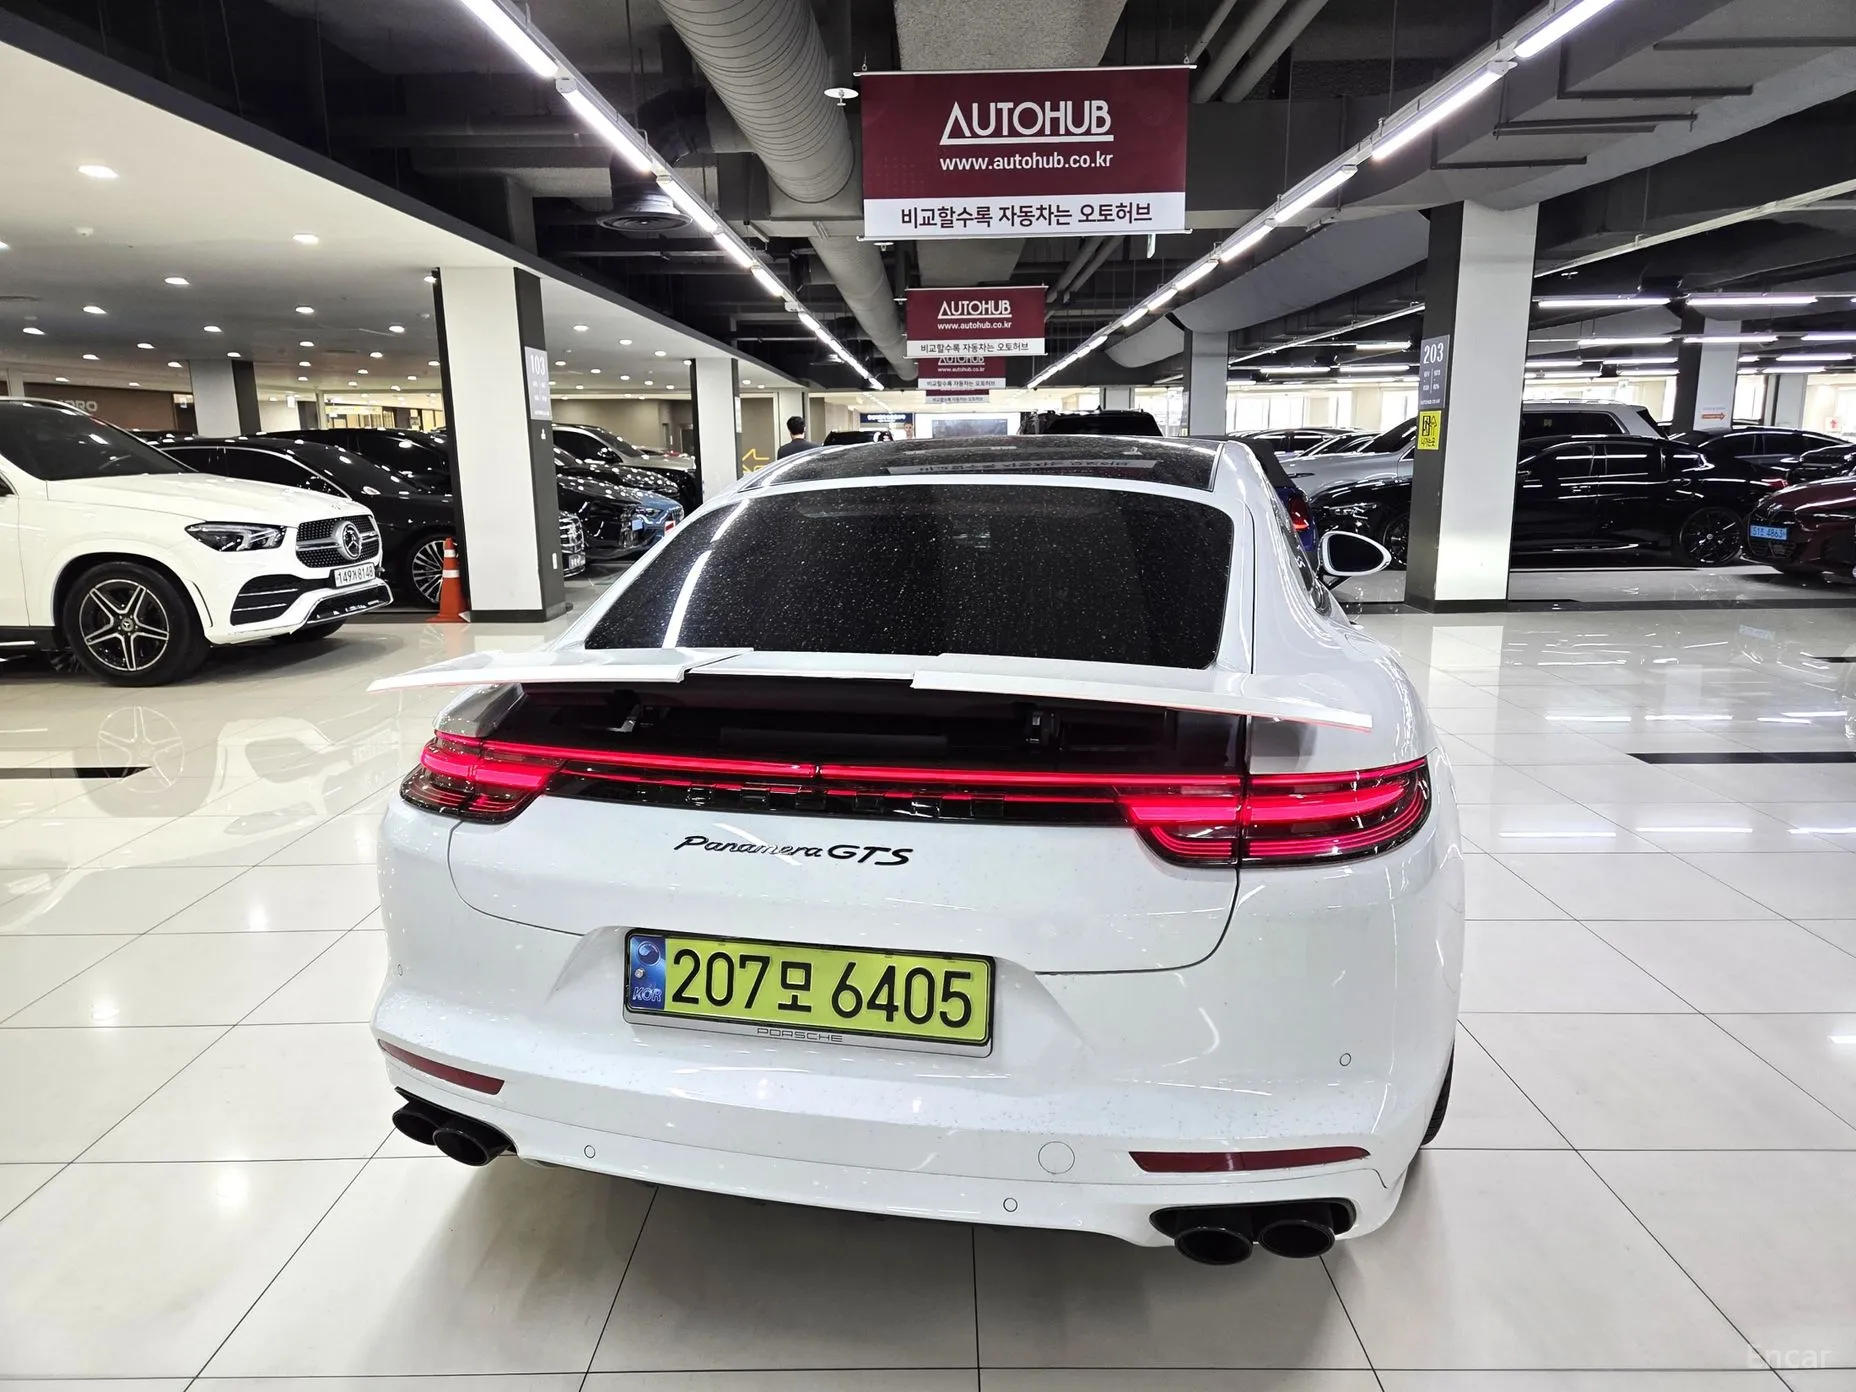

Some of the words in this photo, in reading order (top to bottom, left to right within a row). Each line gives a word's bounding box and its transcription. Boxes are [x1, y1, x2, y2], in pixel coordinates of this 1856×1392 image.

[939, 100, 1114, 145] AUTOHUB
[939, 151, 1114, 171] www.autohub.co.kr
[901, 205, 993, 229] 비교할수록
[998, 204, 1073, 228] 자동차는
[1078, 202, 1153, 225] 오토허브
[937, 300, 1012, 319] AUTOHUB
[937, 321, 1012, 330] www.autohub.co.kr
[920, 343, 961, 354] 비교할수록
[963, 343, 994, 353] 자동차는
[997, 342, 1029, 352] 오토허브
[1423, 343, 1444, 364] 203
[530, 354, 546, 376] 103
[674, 835, 822, 859] Panamera
[827, 844, 914, 867] GTS
[632, 984, 663, 1002] KOR
[671, 948, 813, 1014] 207모
[832, 961, 972, 1029] 6405
[756, 1027, 843, 1043] PORSCHE
